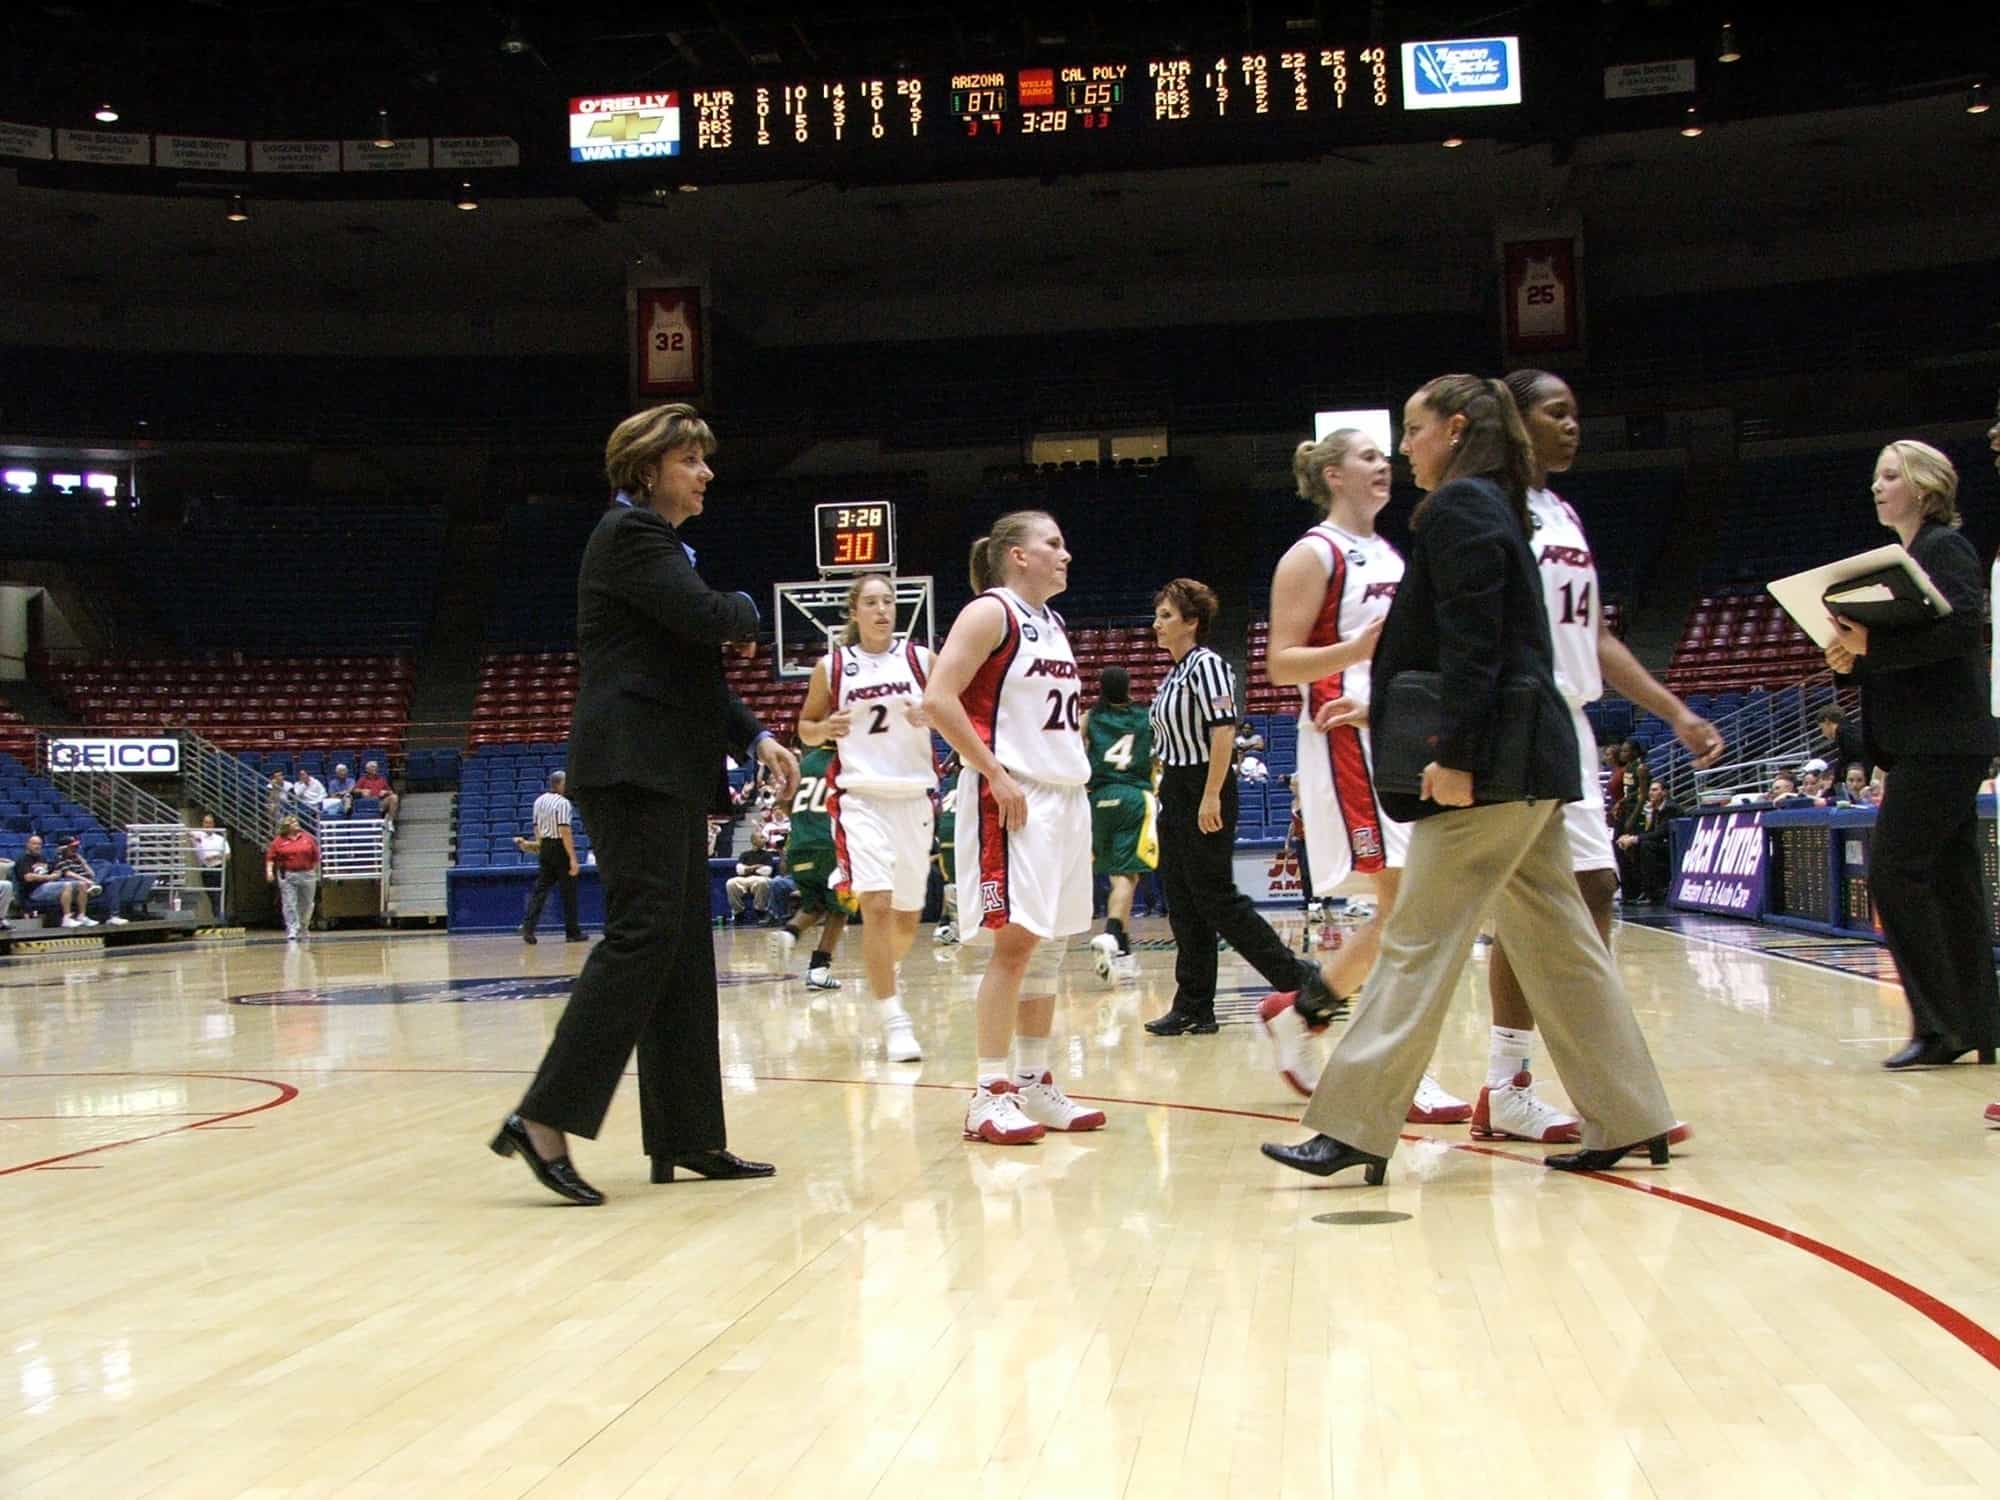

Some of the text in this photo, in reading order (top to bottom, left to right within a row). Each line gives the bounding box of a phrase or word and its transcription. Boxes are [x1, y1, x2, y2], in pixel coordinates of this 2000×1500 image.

[1149, 61, 1191, 77] PLYR
[1241, 55, 1266, 71] 20
[1281, 52, 1306, 69] 22
[1320, 50, 1345, 66] 25
[1360, 47, 1385, 63] 40
[952, 73, 1005, 89] ARIZONA
[1061, 65, 1127, 82] CAL POLY
[1157, 75, 1186, 91] PTS
[693, 91, 734, 107] PLYR
[785, 86, 808, 101] 10
[823, 83, 846, 99] 14
[861, 81, 883, 97] 15
[897, 79, 921, 95] 20
[968, 91, 995, 112] 87
[1084, 84, 1111, 105] 65
[1155, 90, 1190, 105] RBS
[700, 106, 729, 120] PTS
[1021, 110, 1068, 133] 3:28
[1156, 104, 1190, 120] FLS
[581, 142, 671, 160] WATSON
[698, 134, 732, 149] FLS
[1527, 283, 1555, 305] 25
[655, 332, 684, 351] 32
[837, 508, 882, 528] 3:28
[834, 532, 874, 562] 30
[1559, 579, 1591, 627] 14
[845, 682, 912, 706] ARIZONA
[868, 704, 890, 735] 2
[1042, 688, 1080, 732] 20
[52, 744, 176, 767] GEICO
[1104, 733, 1135, 771] 4
[1682, 815, 1722, 873] Jack
